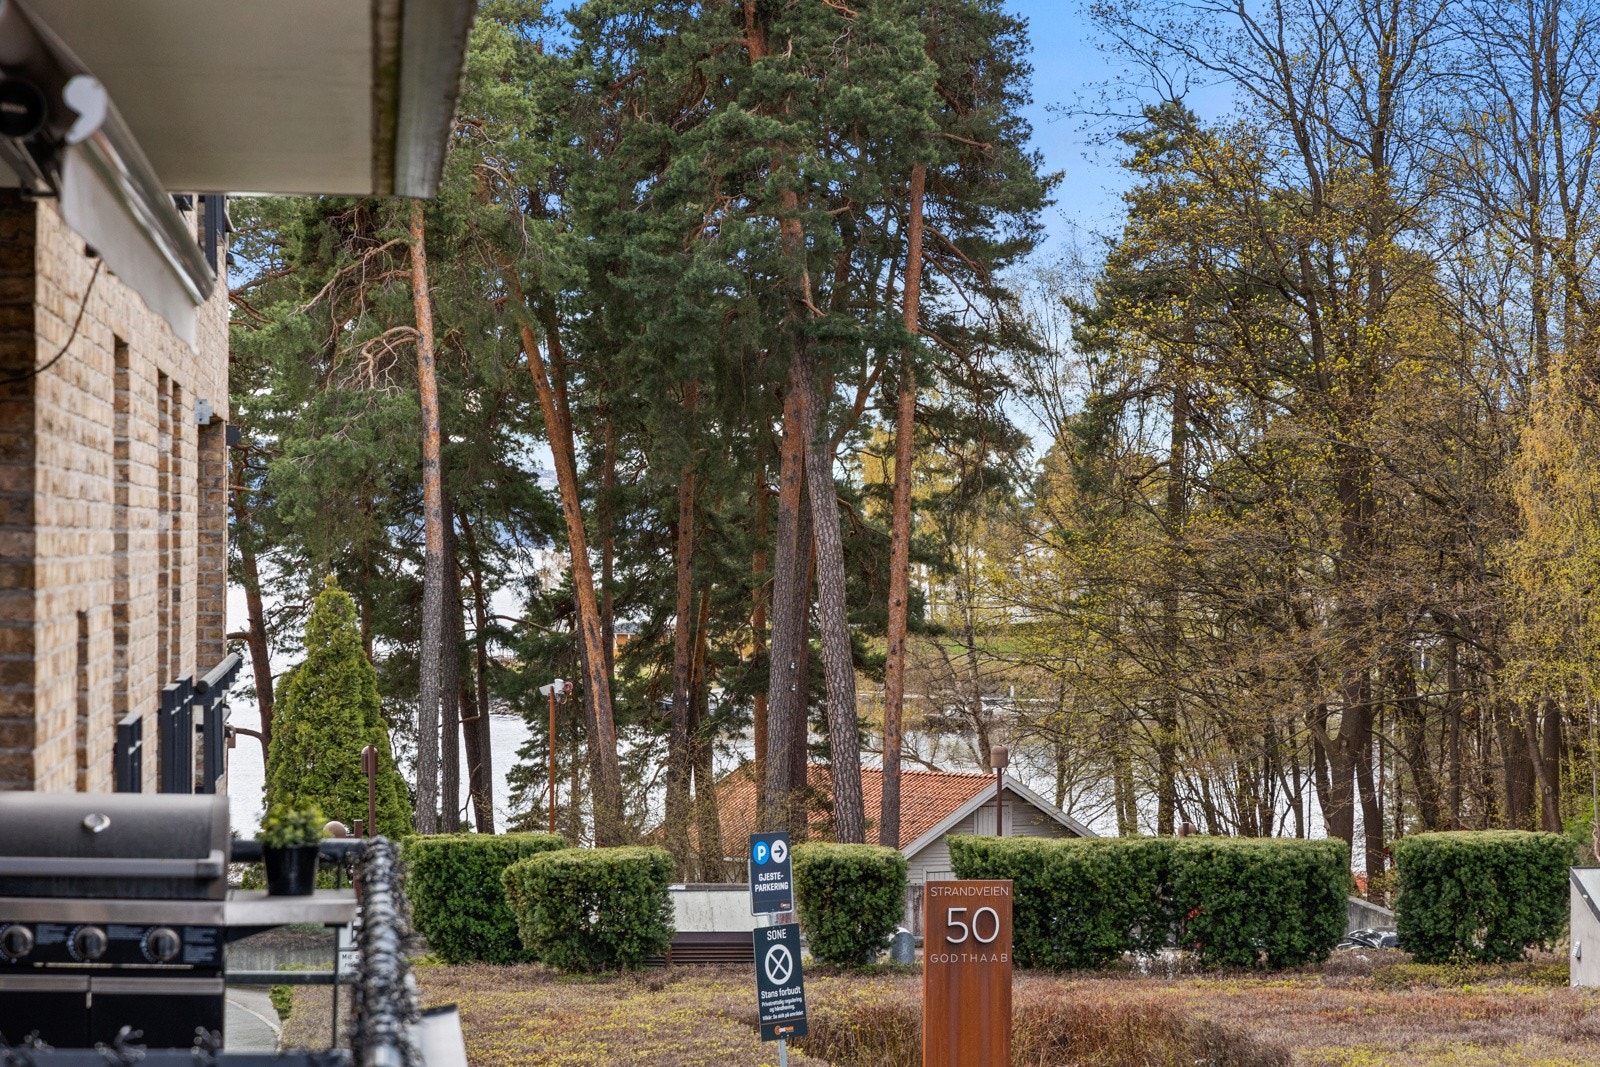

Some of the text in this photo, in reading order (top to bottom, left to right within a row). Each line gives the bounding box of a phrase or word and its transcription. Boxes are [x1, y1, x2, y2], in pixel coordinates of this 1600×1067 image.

[757, 846, 767, 861] P
[758, 872, 784, 881] GJESTE-
[755, 882, 789, 892] PARKERING
[930, 886, 1009, 897] STRANDVEIEN
[946, 906, 1000, 944] 50
[766, 928, 787, 941] SONE
[930, 953, 1008, 964] GODTHAAB
[760, 986, 801, 999] Stans forbudt
